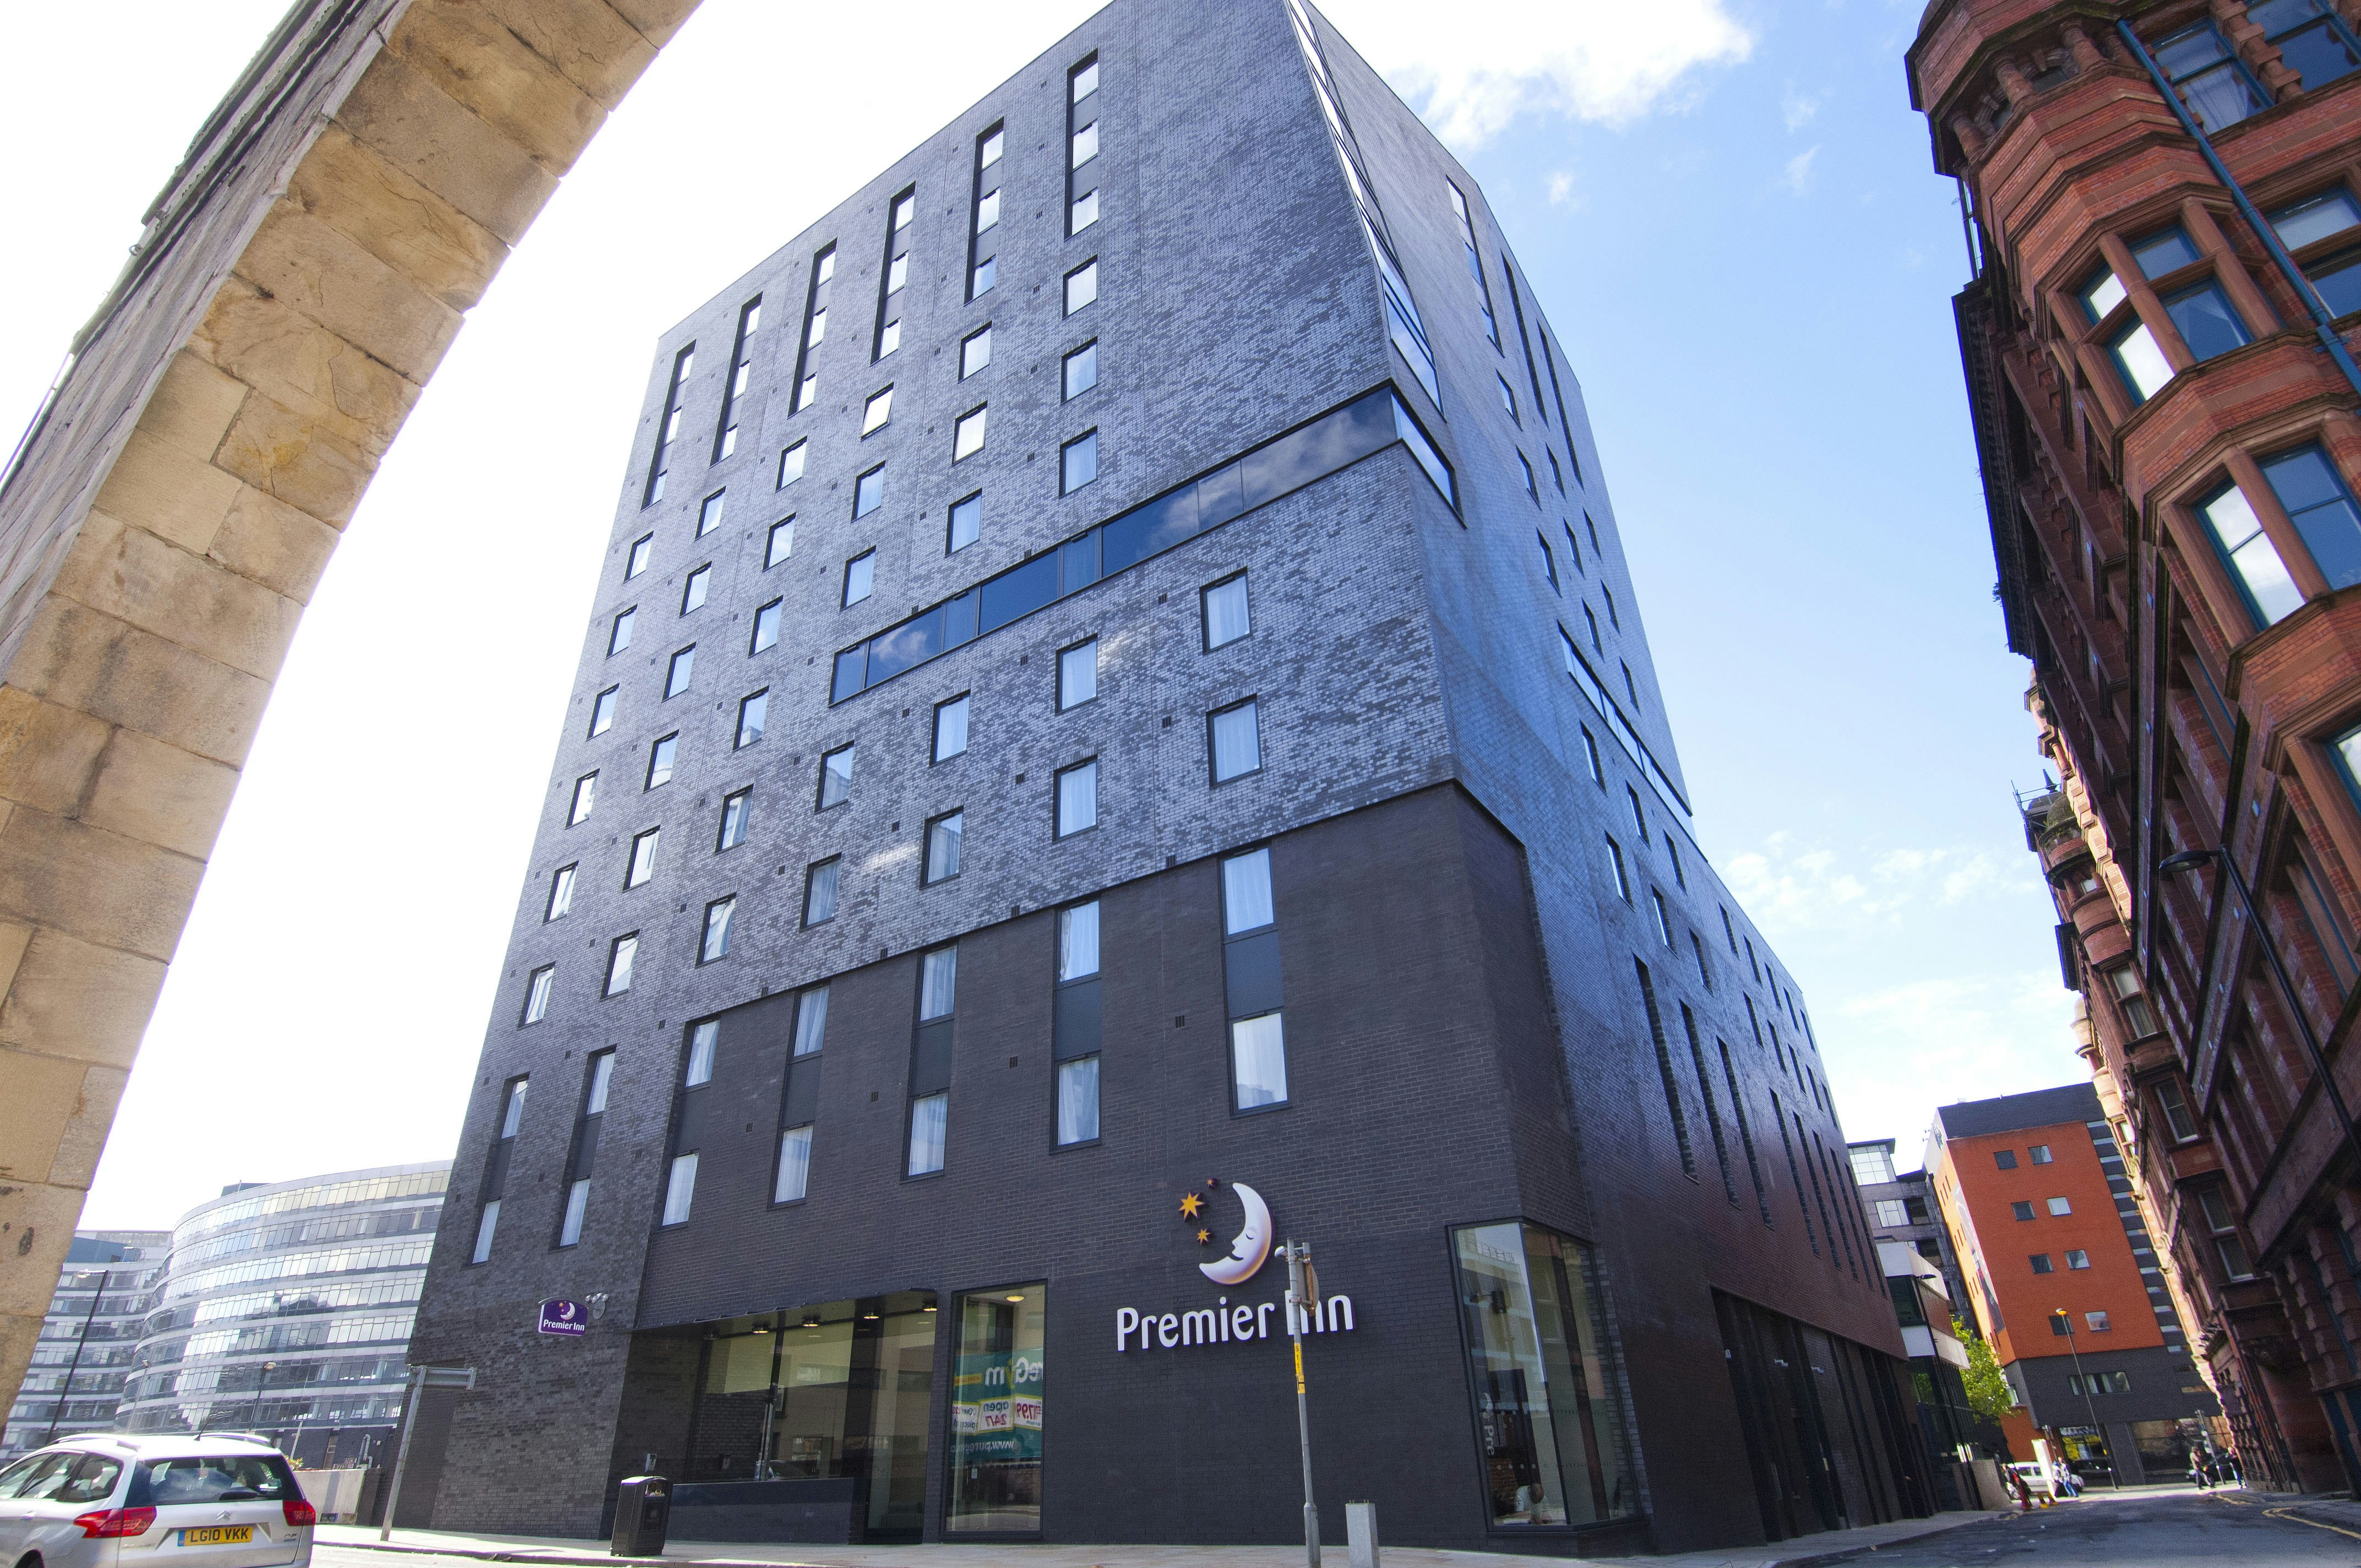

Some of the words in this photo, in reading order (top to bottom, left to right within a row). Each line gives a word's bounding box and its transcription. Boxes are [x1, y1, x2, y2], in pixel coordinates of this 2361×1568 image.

[543, 1319, 573, 1330] Premier
[573, 1322, 585, 1331] Inn
[1117, 1296, 1275, 1352] Premier
[190, 1529, 220, 1543] LG10
[225, 1527, 249, 1540] VKK
